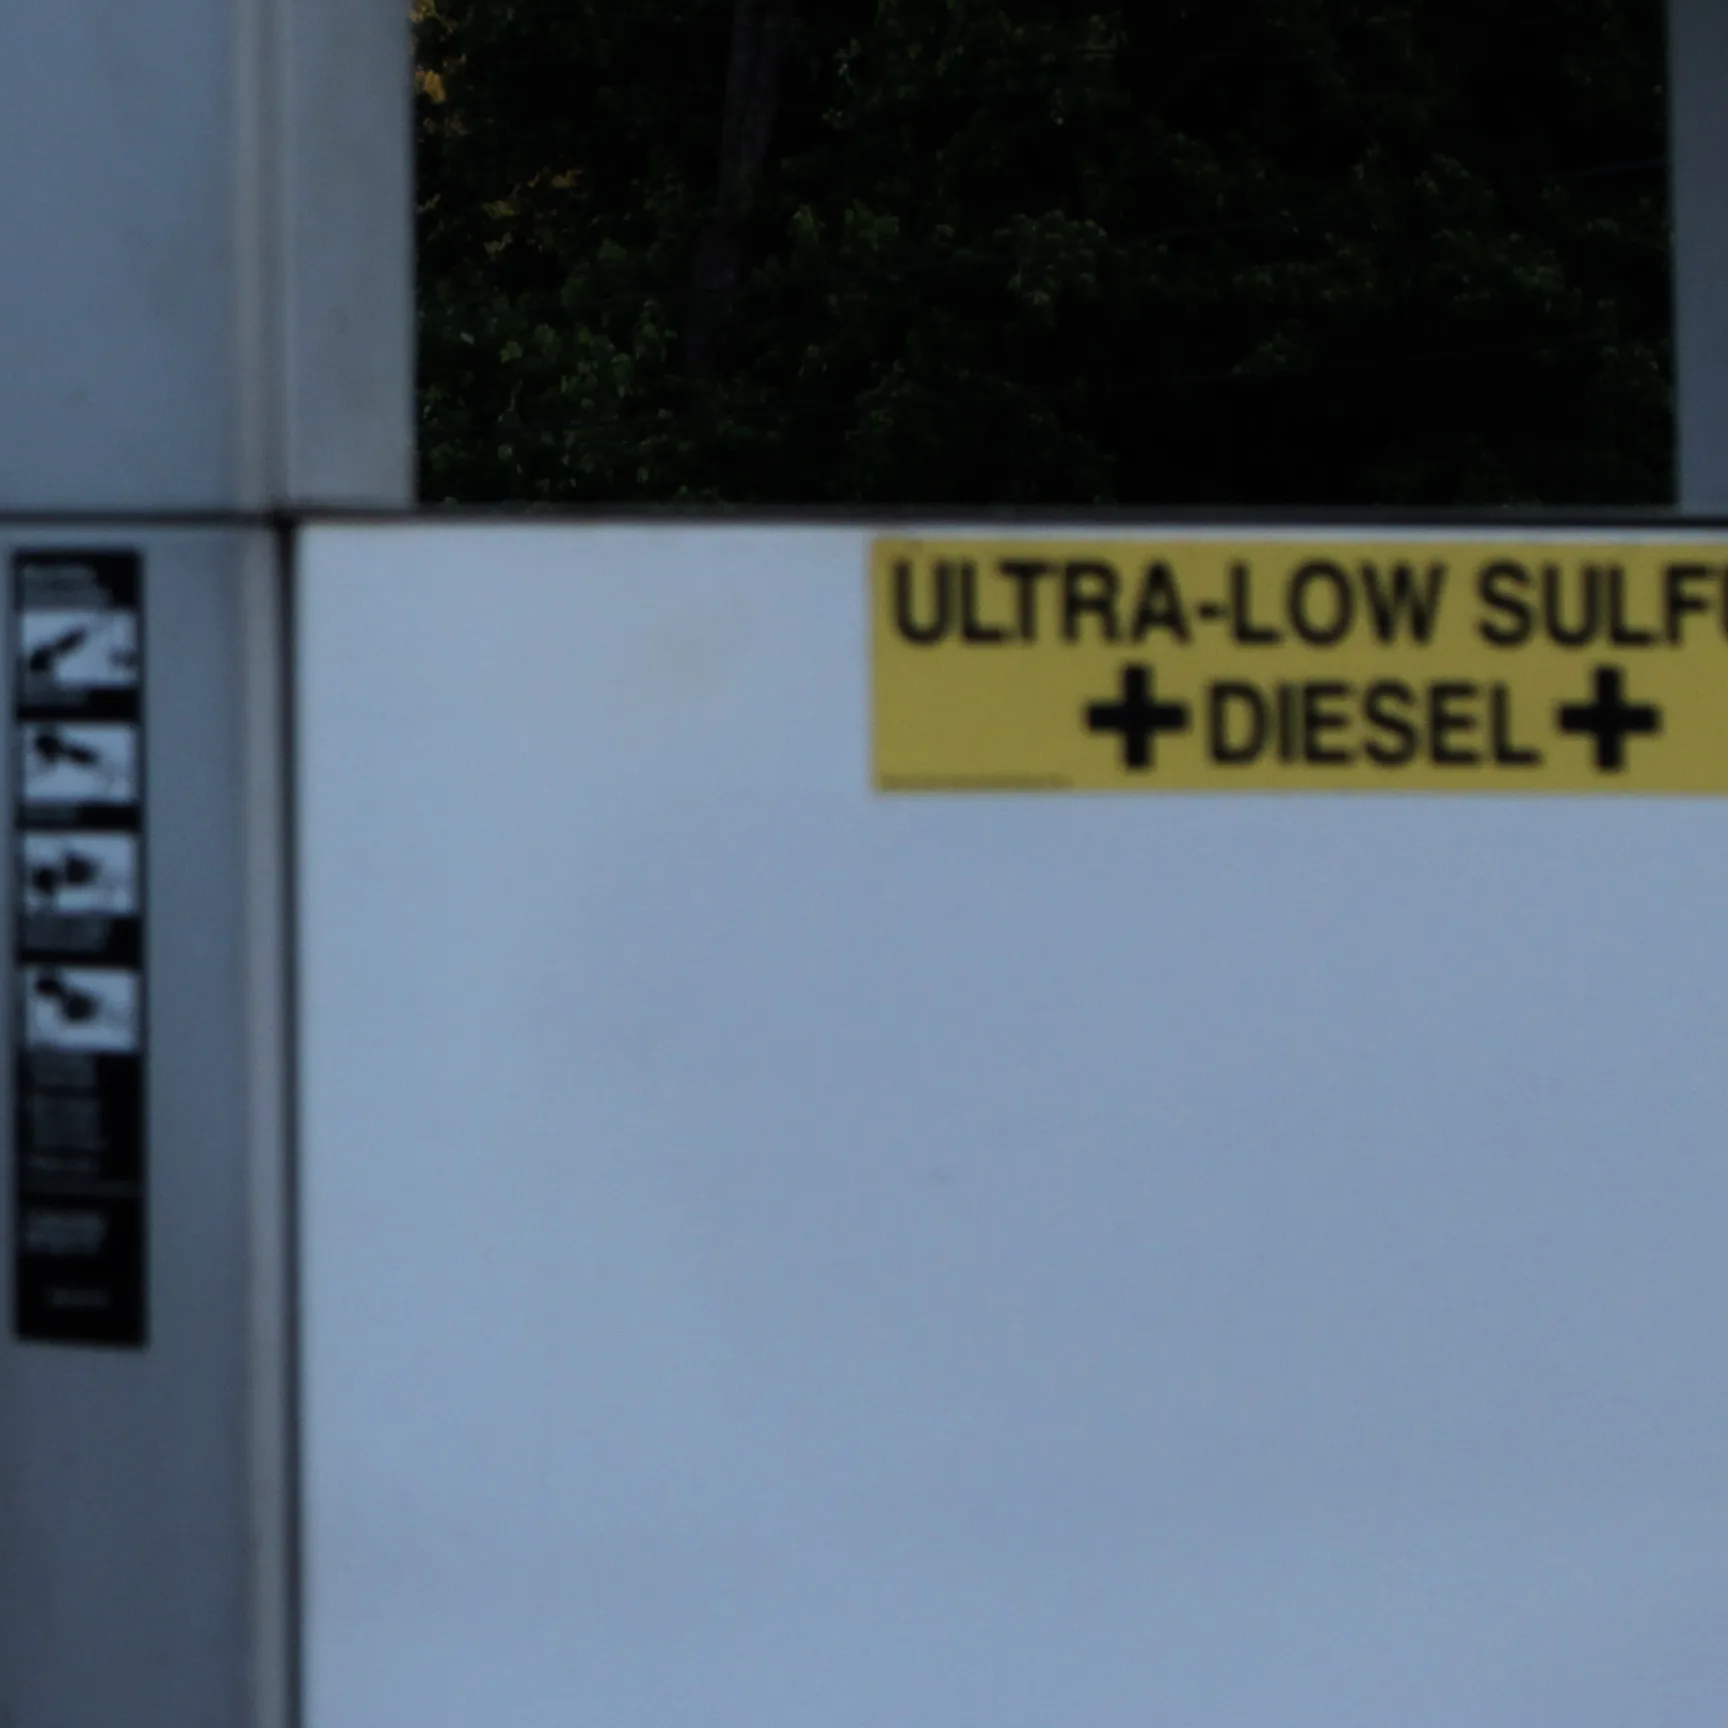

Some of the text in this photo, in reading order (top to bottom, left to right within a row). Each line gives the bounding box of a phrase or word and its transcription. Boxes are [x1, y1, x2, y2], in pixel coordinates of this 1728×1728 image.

[892, 558, 1728, 647] ULTRA-LOW SULF
[1207, 680, 1539, 768] DIESEL
